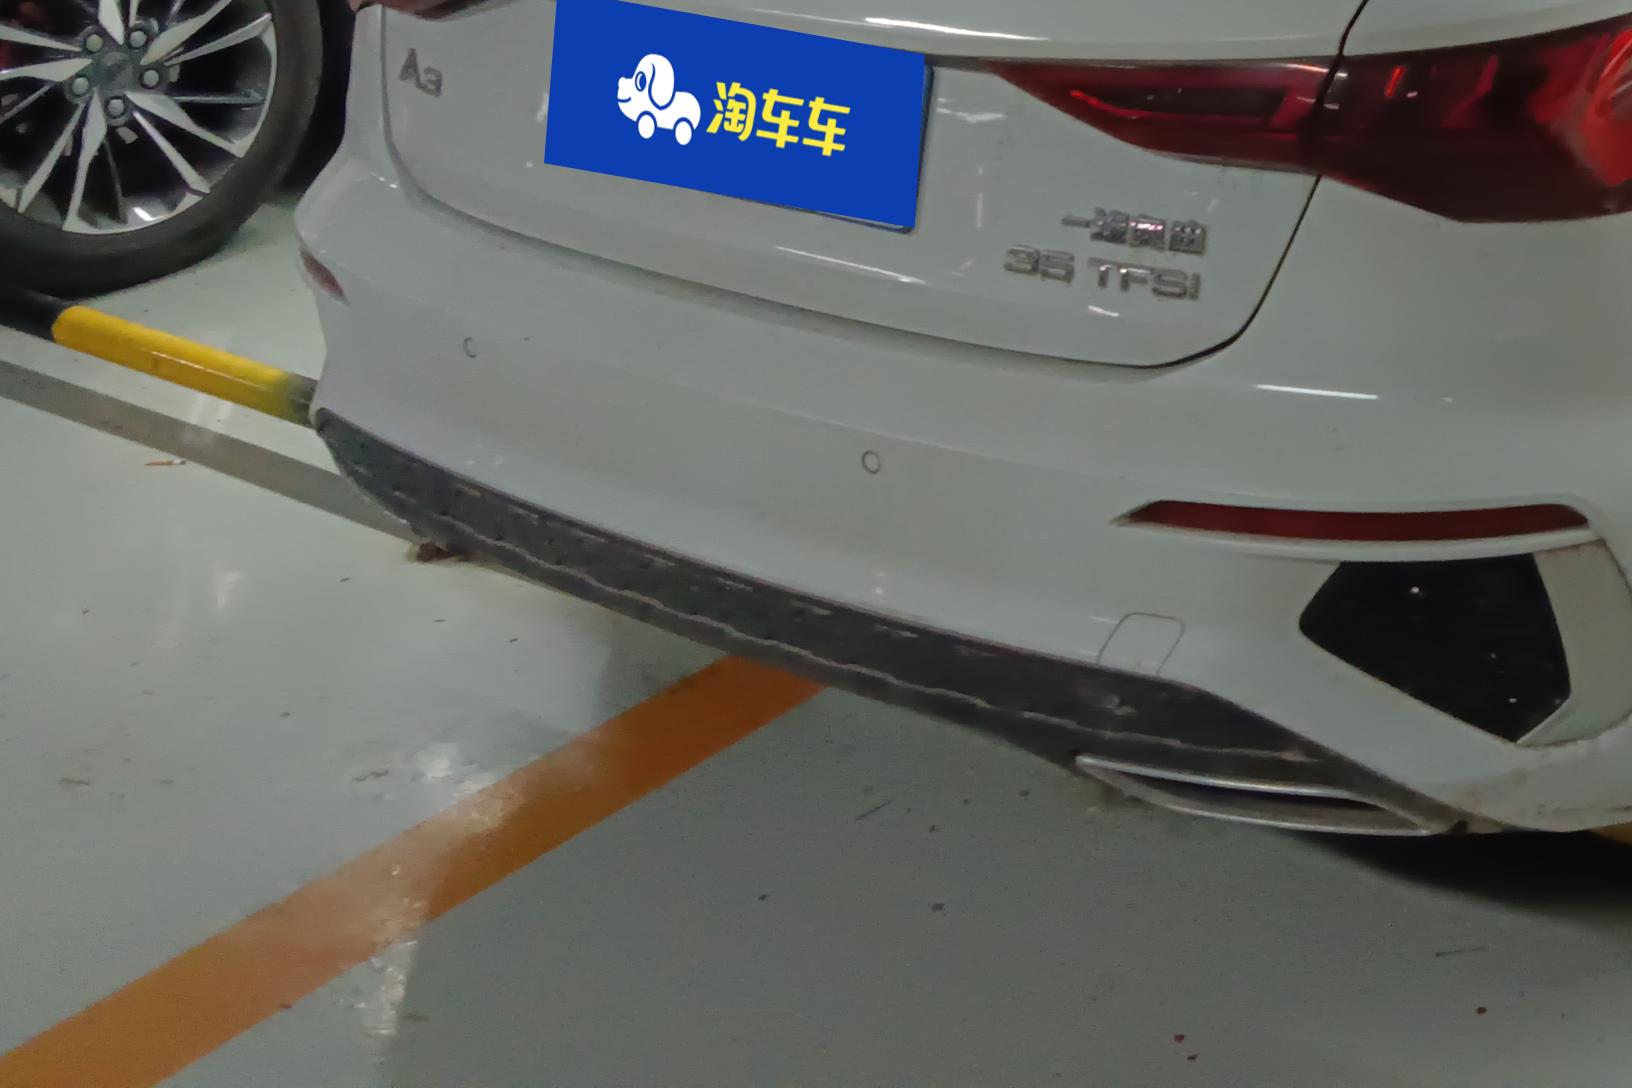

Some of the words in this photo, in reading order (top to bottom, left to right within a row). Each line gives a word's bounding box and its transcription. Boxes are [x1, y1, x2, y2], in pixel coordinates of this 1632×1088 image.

[398, 47, 443, 98] A3
[1003, 243, 1075, 286] 35
[1087, 256, 1203, 300] TFSI
